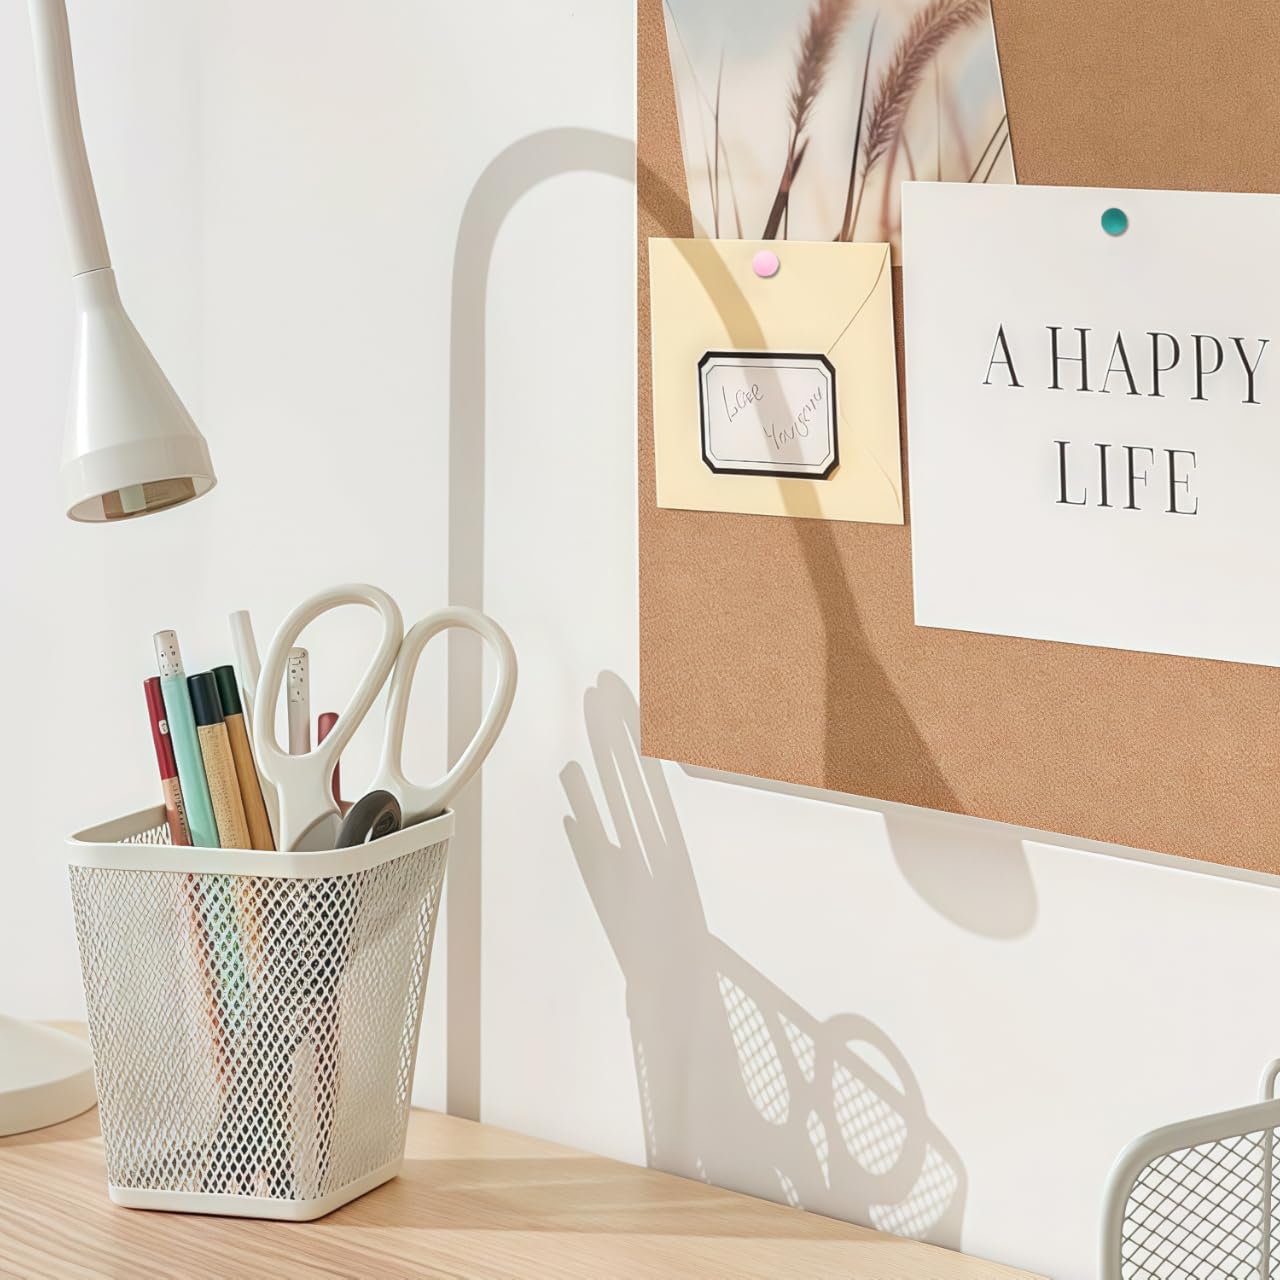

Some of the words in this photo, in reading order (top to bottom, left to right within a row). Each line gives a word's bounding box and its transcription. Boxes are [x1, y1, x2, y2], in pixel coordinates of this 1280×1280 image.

[981, 321, 1025, 388] A
[1045, 325, 1271, 405] HAPPY
[1053, 440, 1199, 516] LIFE
